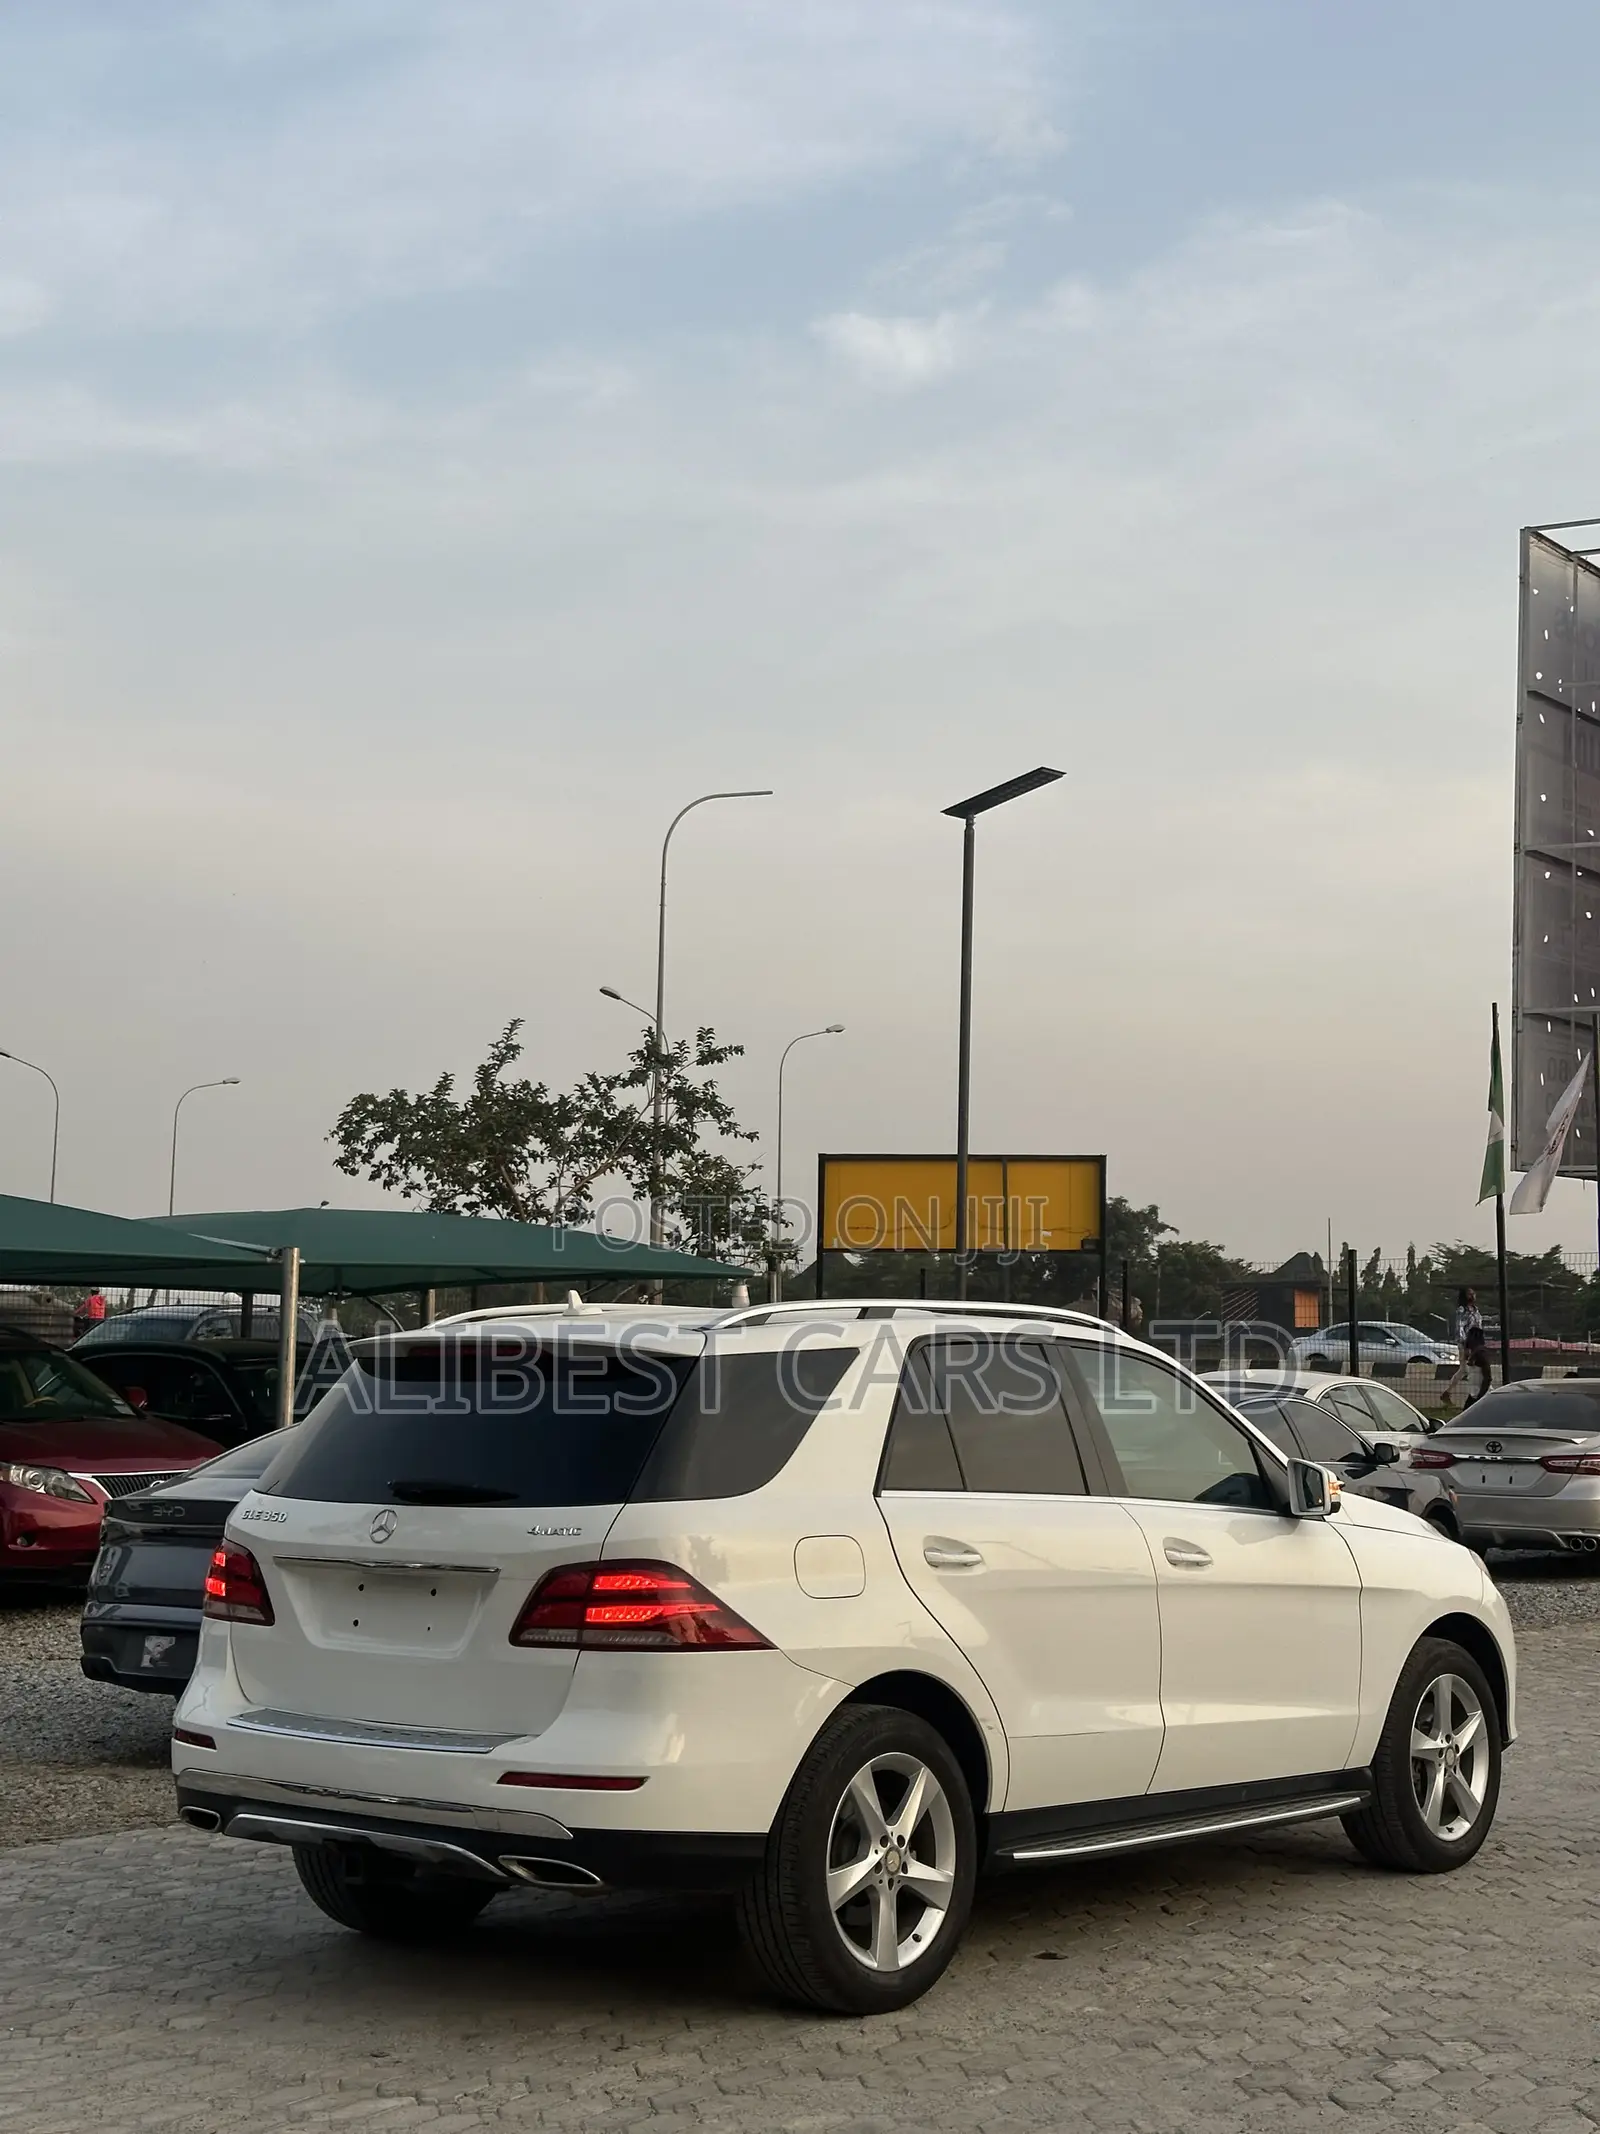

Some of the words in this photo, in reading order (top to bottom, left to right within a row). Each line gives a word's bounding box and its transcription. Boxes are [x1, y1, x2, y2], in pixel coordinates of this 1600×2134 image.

[152, 1505, 186, 1518] BYD
[241, 1509, 261, 1521] GLE
[263, 1511, 287, 1523] 350
